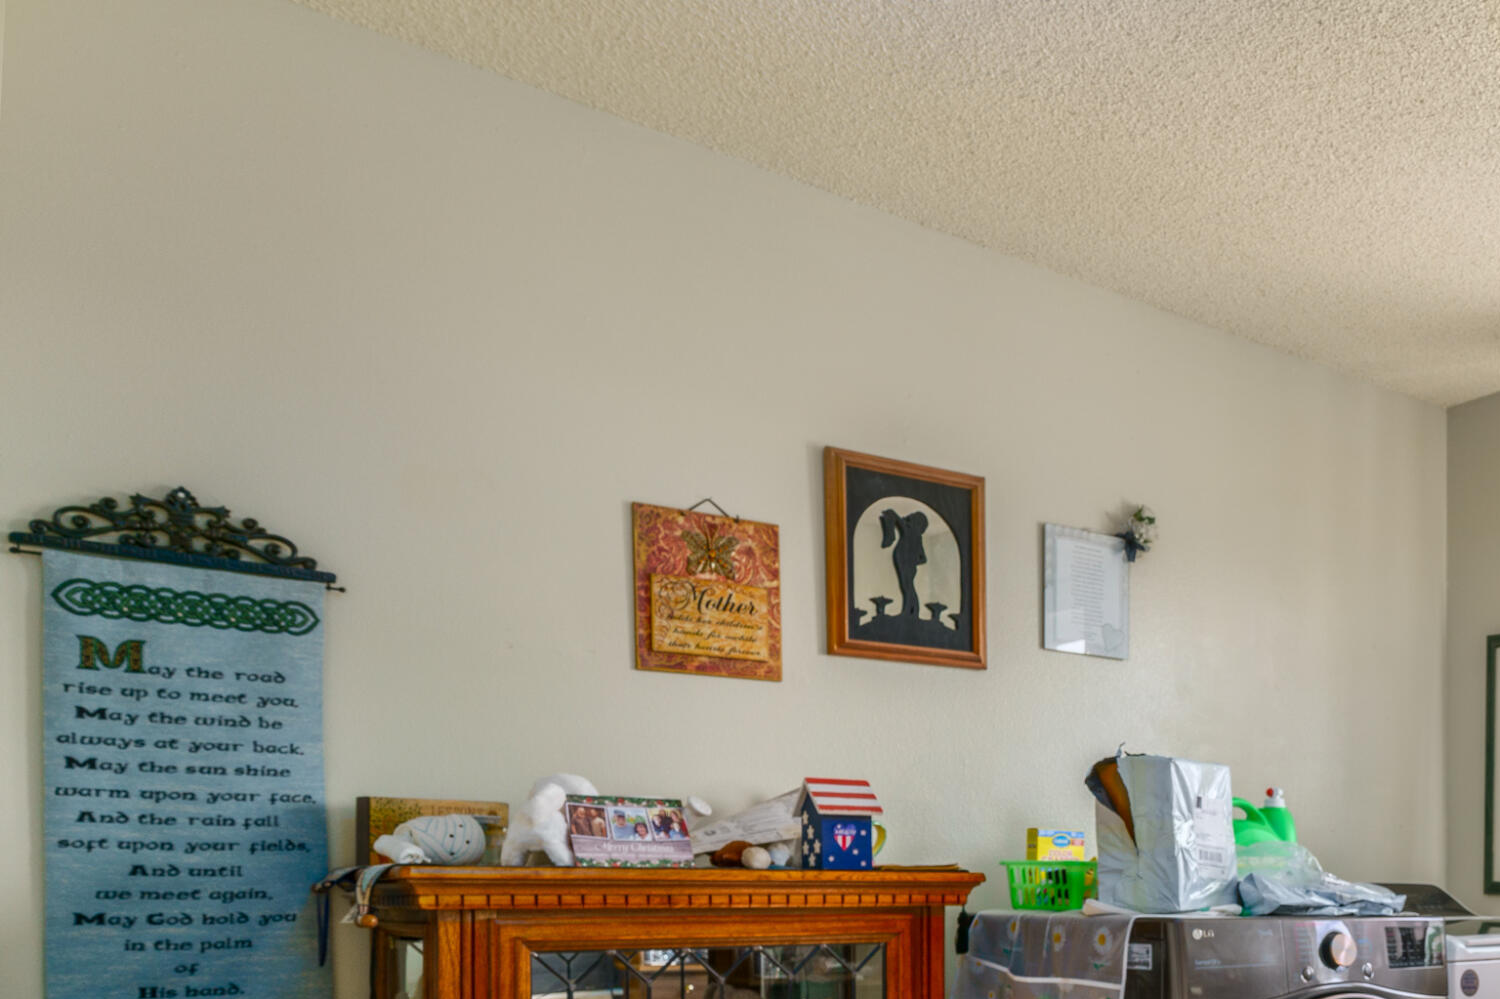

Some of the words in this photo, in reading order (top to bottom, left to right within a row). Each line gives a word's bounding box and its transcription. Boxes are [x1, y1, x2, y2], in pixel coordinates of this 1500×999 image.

[660, 581, 758, 615] Mother
[706, 631, 721, 640] for
[76, 635, 178, 677] May
[186, 667, 224, 680] the
[235, 671, 286, 684] road
[63, 682, 112, 695] rise
[121, 689, 148, 701] up
[157, 689, 181, 700] to
[190, 693, 248, 705] meet
[75, 705, 139, 725] May
[148, 712, 187, 725] the
[194, 715, 251, 728] wind
[259, 717, 284, 730] be
[56, 732, 146, 749] always
[154, 737, 178, 749] at
[188, 742, 244, 753] your
[253, 741, 305, 755] back.
[64, 756, 128, 774] May
[138, 761, 177, 774] the
[185, 764, 227, 775] sun
[234, 764, 292, 777] shine
[54, 786, 129, 799] warm
[140, 788, 197, 803] upon
[206, 792, 261, 804] your
[76, 811, 129, 825] And
[138, 814, 177, 826] the
[188, 815, 236, 827] rain
[242, 815, 280, 830] fall
[58, 838, 110, 852] soft
[117, 839, 175, 852] upon
[184, 841, 240, 854] your
[128, 865, 181, 877] And
[188, 865, 244, 877] until
[95, 890, 132, 900] we
[140, 889, 202, 900] meet
[73, 912, 138, 928] May
[146, 912, 194, 926] God
[202, 911, 250, 925] hold
[258, 913, 297, 926] you
[1203, 929, 1215, 938] LG
[124, 940, 145, 951] in
[154, 939, 193, 951] the
[201, 937, 253, 953] palm
[174, 963, 201, 975] of
[138, 986, 177, 999] His
